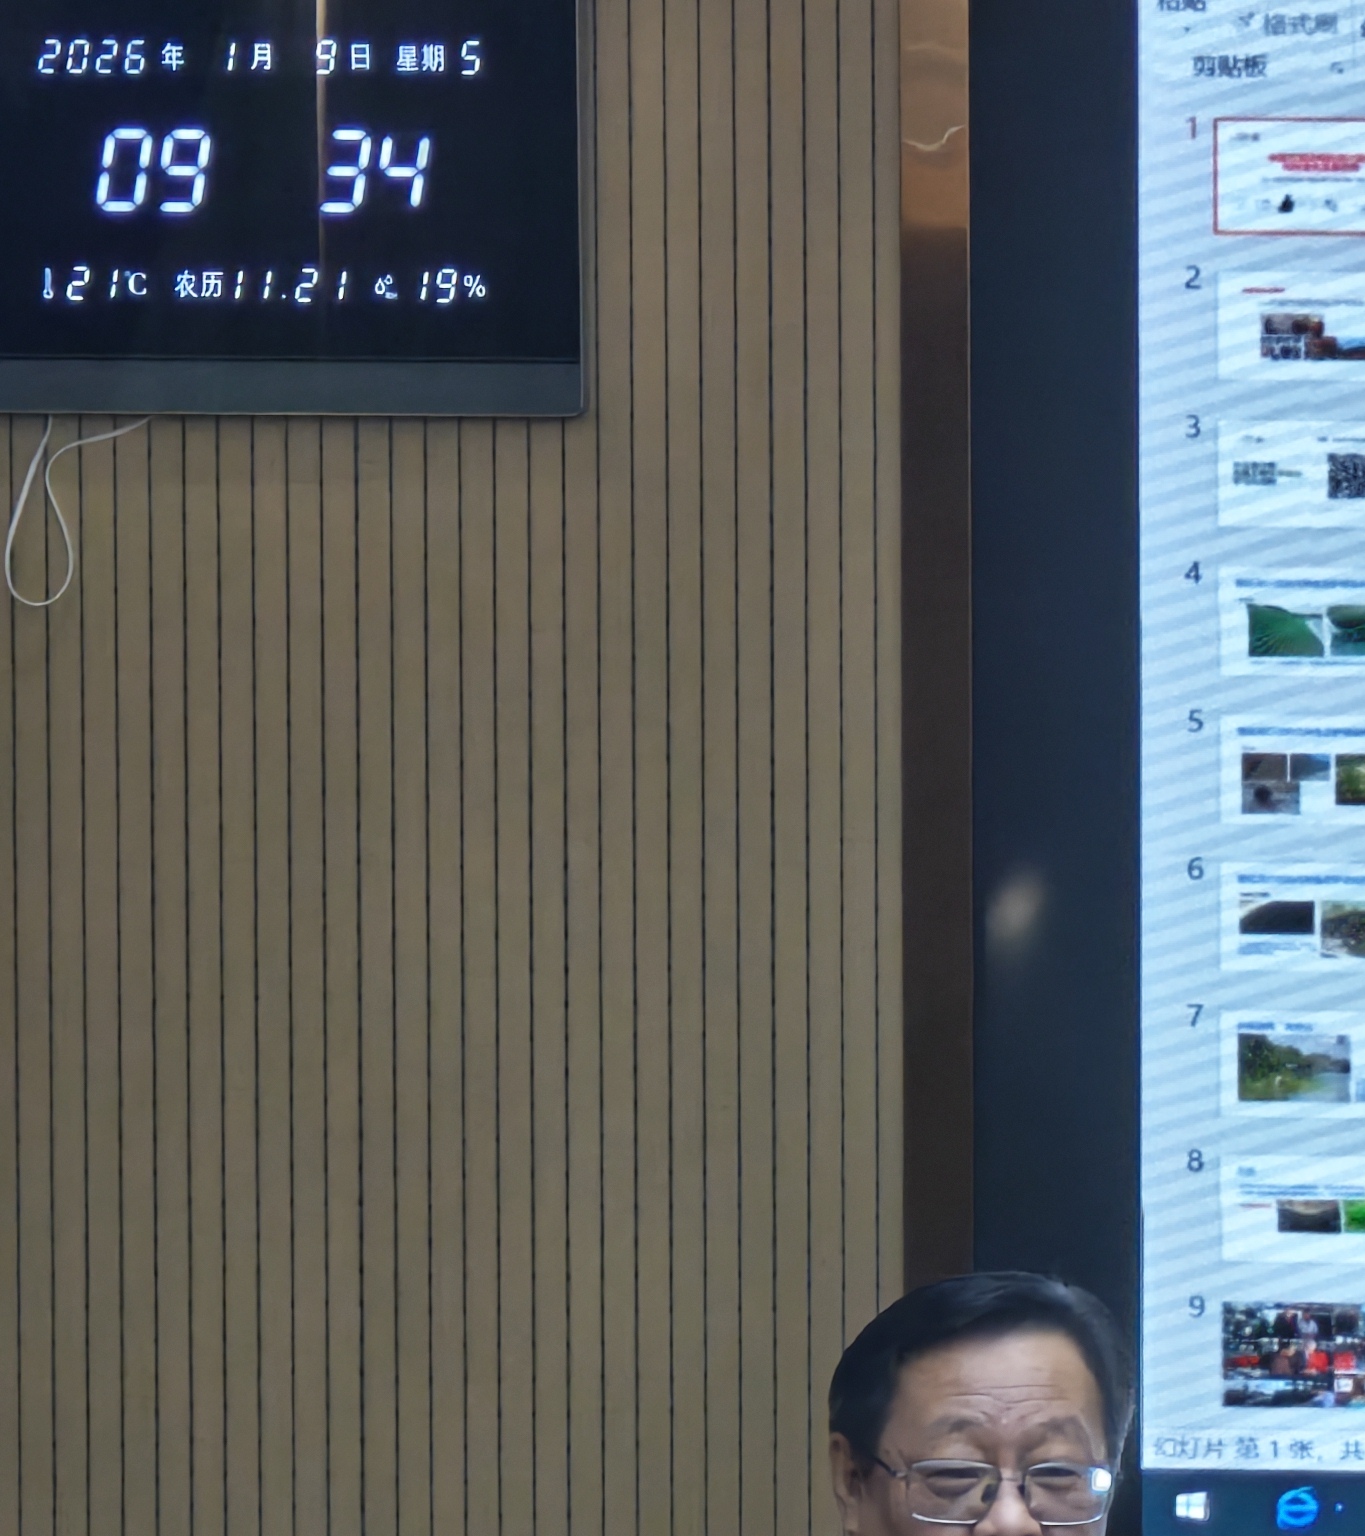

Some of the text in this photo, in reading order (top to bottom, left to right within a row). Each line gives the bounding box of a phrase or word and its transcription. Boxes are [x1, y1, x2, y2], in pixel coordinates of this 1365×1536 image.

[1186, 117, 1198, 141] 1
[97, 127, 431, 214] 09 34
[418, 268, 486, 303] 19%
[1184, 266, 1202, 290] 2
[1185, 415, 1201, 439] 3
[1184, 561, 1202, 585] 4
[1188, 710, 1204, 733] 5
[1187, 857, 1204, 881] 6
[1186, 1004, 1204, 1028] 7
[1187, 1149, 1204, 1173] 8
[1188, 1296, 1206, 1319] 9
